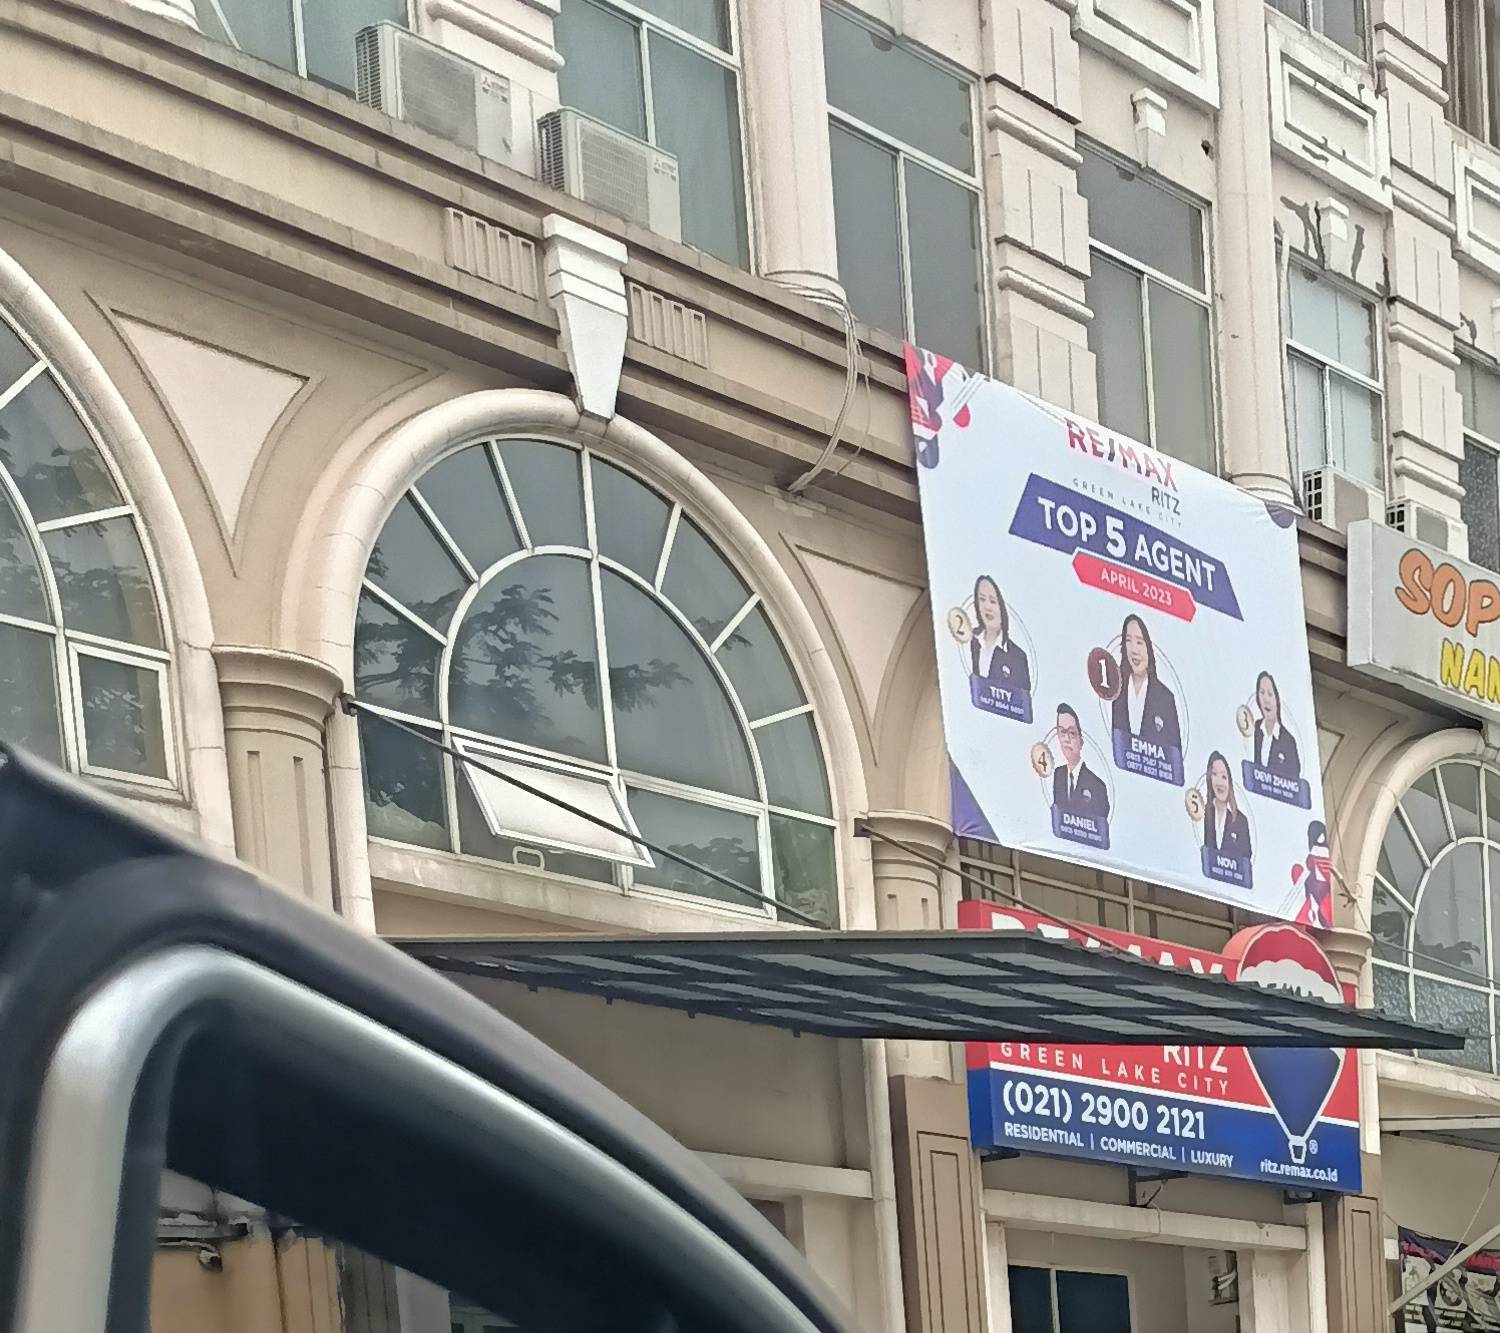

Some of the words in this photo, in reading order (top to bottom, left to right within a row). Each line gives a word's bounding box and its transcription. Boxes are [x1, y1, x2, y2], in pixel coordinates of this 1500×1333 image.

[1152, 485, 1181, 516] RITZ
[1038, 496, 1097, 543] TOP
[1105, 514, 1127, 558] 5
[1134, 533, 1216, 592] AGENT
[1101, 567, 1140, 595] APRIL
[1142, 582, 1173, 606] 2023
[954, 614, 966, 636] 2
[1098, 658, 1111, 689] 1
[1038, 751, 1048, 773] 4
[1131, 737, 1166, 761] EMMA
[1063, 813, 1098, 833] DANIEL
[1001, 1041, 1084, 1071] GREEN
[1101, 1058, 1161, 1085] LAKE
[1177, 1072, 1229, 1096] CITY
[1003, 1079, 1073, 1124] (021)
[1081, 1092, 1149, 1132] 2900
[1157, 1104, 1206, 1141] 2121
[1004, 1121, 1085, 1148] RESIDENTIAL
[1100, 1136, 1177, 1162] COMMERCIAL
[1190, 1150, 1234, 1169] LUXURY
